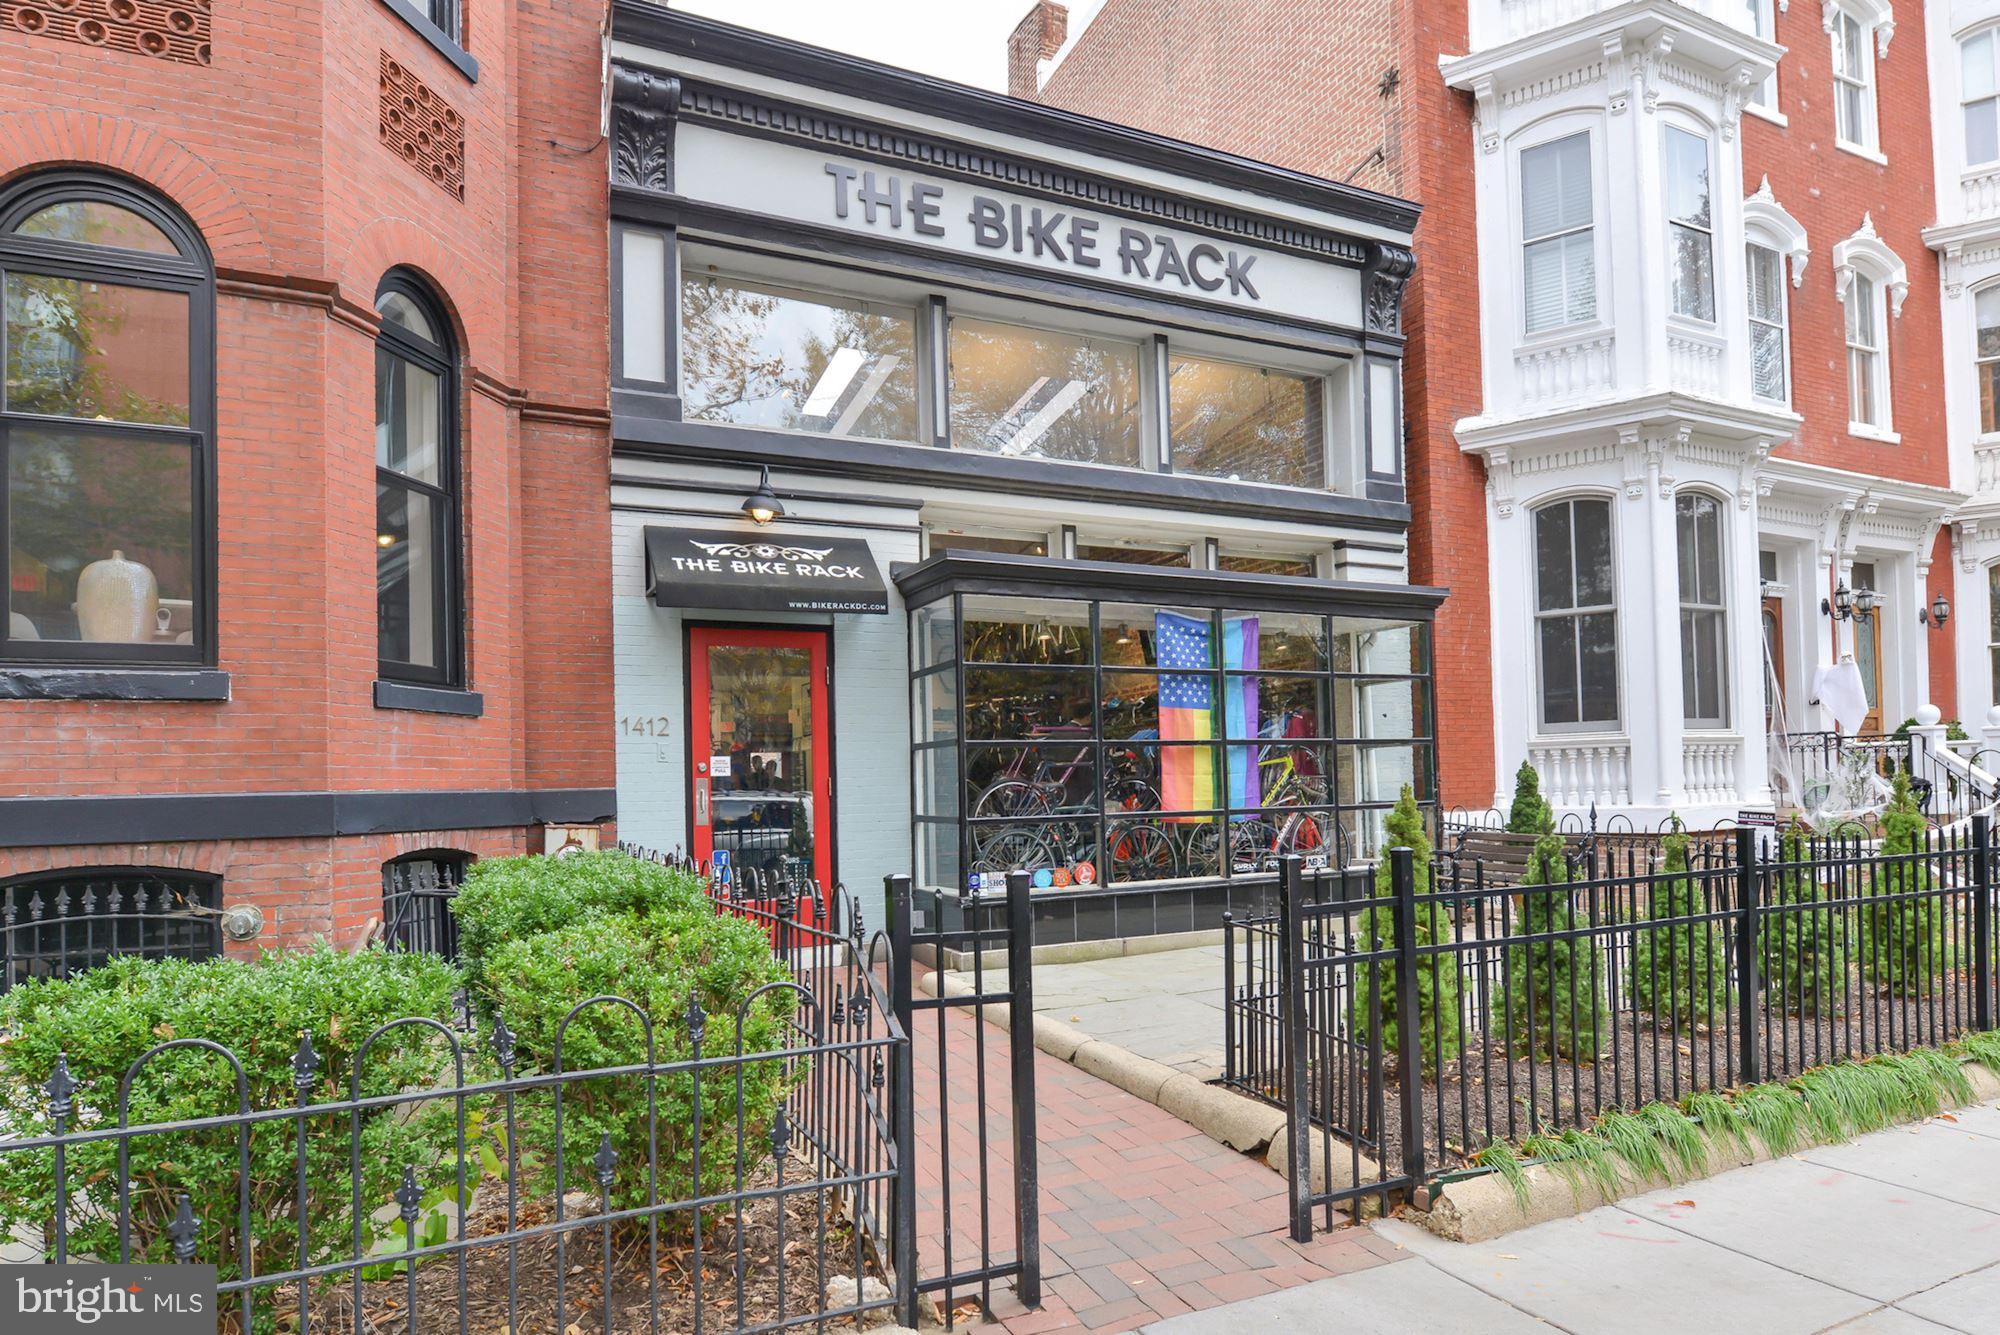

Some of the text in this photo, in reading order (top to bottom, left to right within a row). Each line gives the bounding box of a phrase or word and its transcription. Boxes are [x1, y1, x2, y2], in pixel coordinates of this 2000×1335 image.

[824, 162, 1260, 300] THE BIKE RACK
[671, 557, 865, 579] THE BIKE RACK
[789, 601, 886, 611] WWW.BIKERACKDC.COM
[621, 716, 669, 737] 1412
